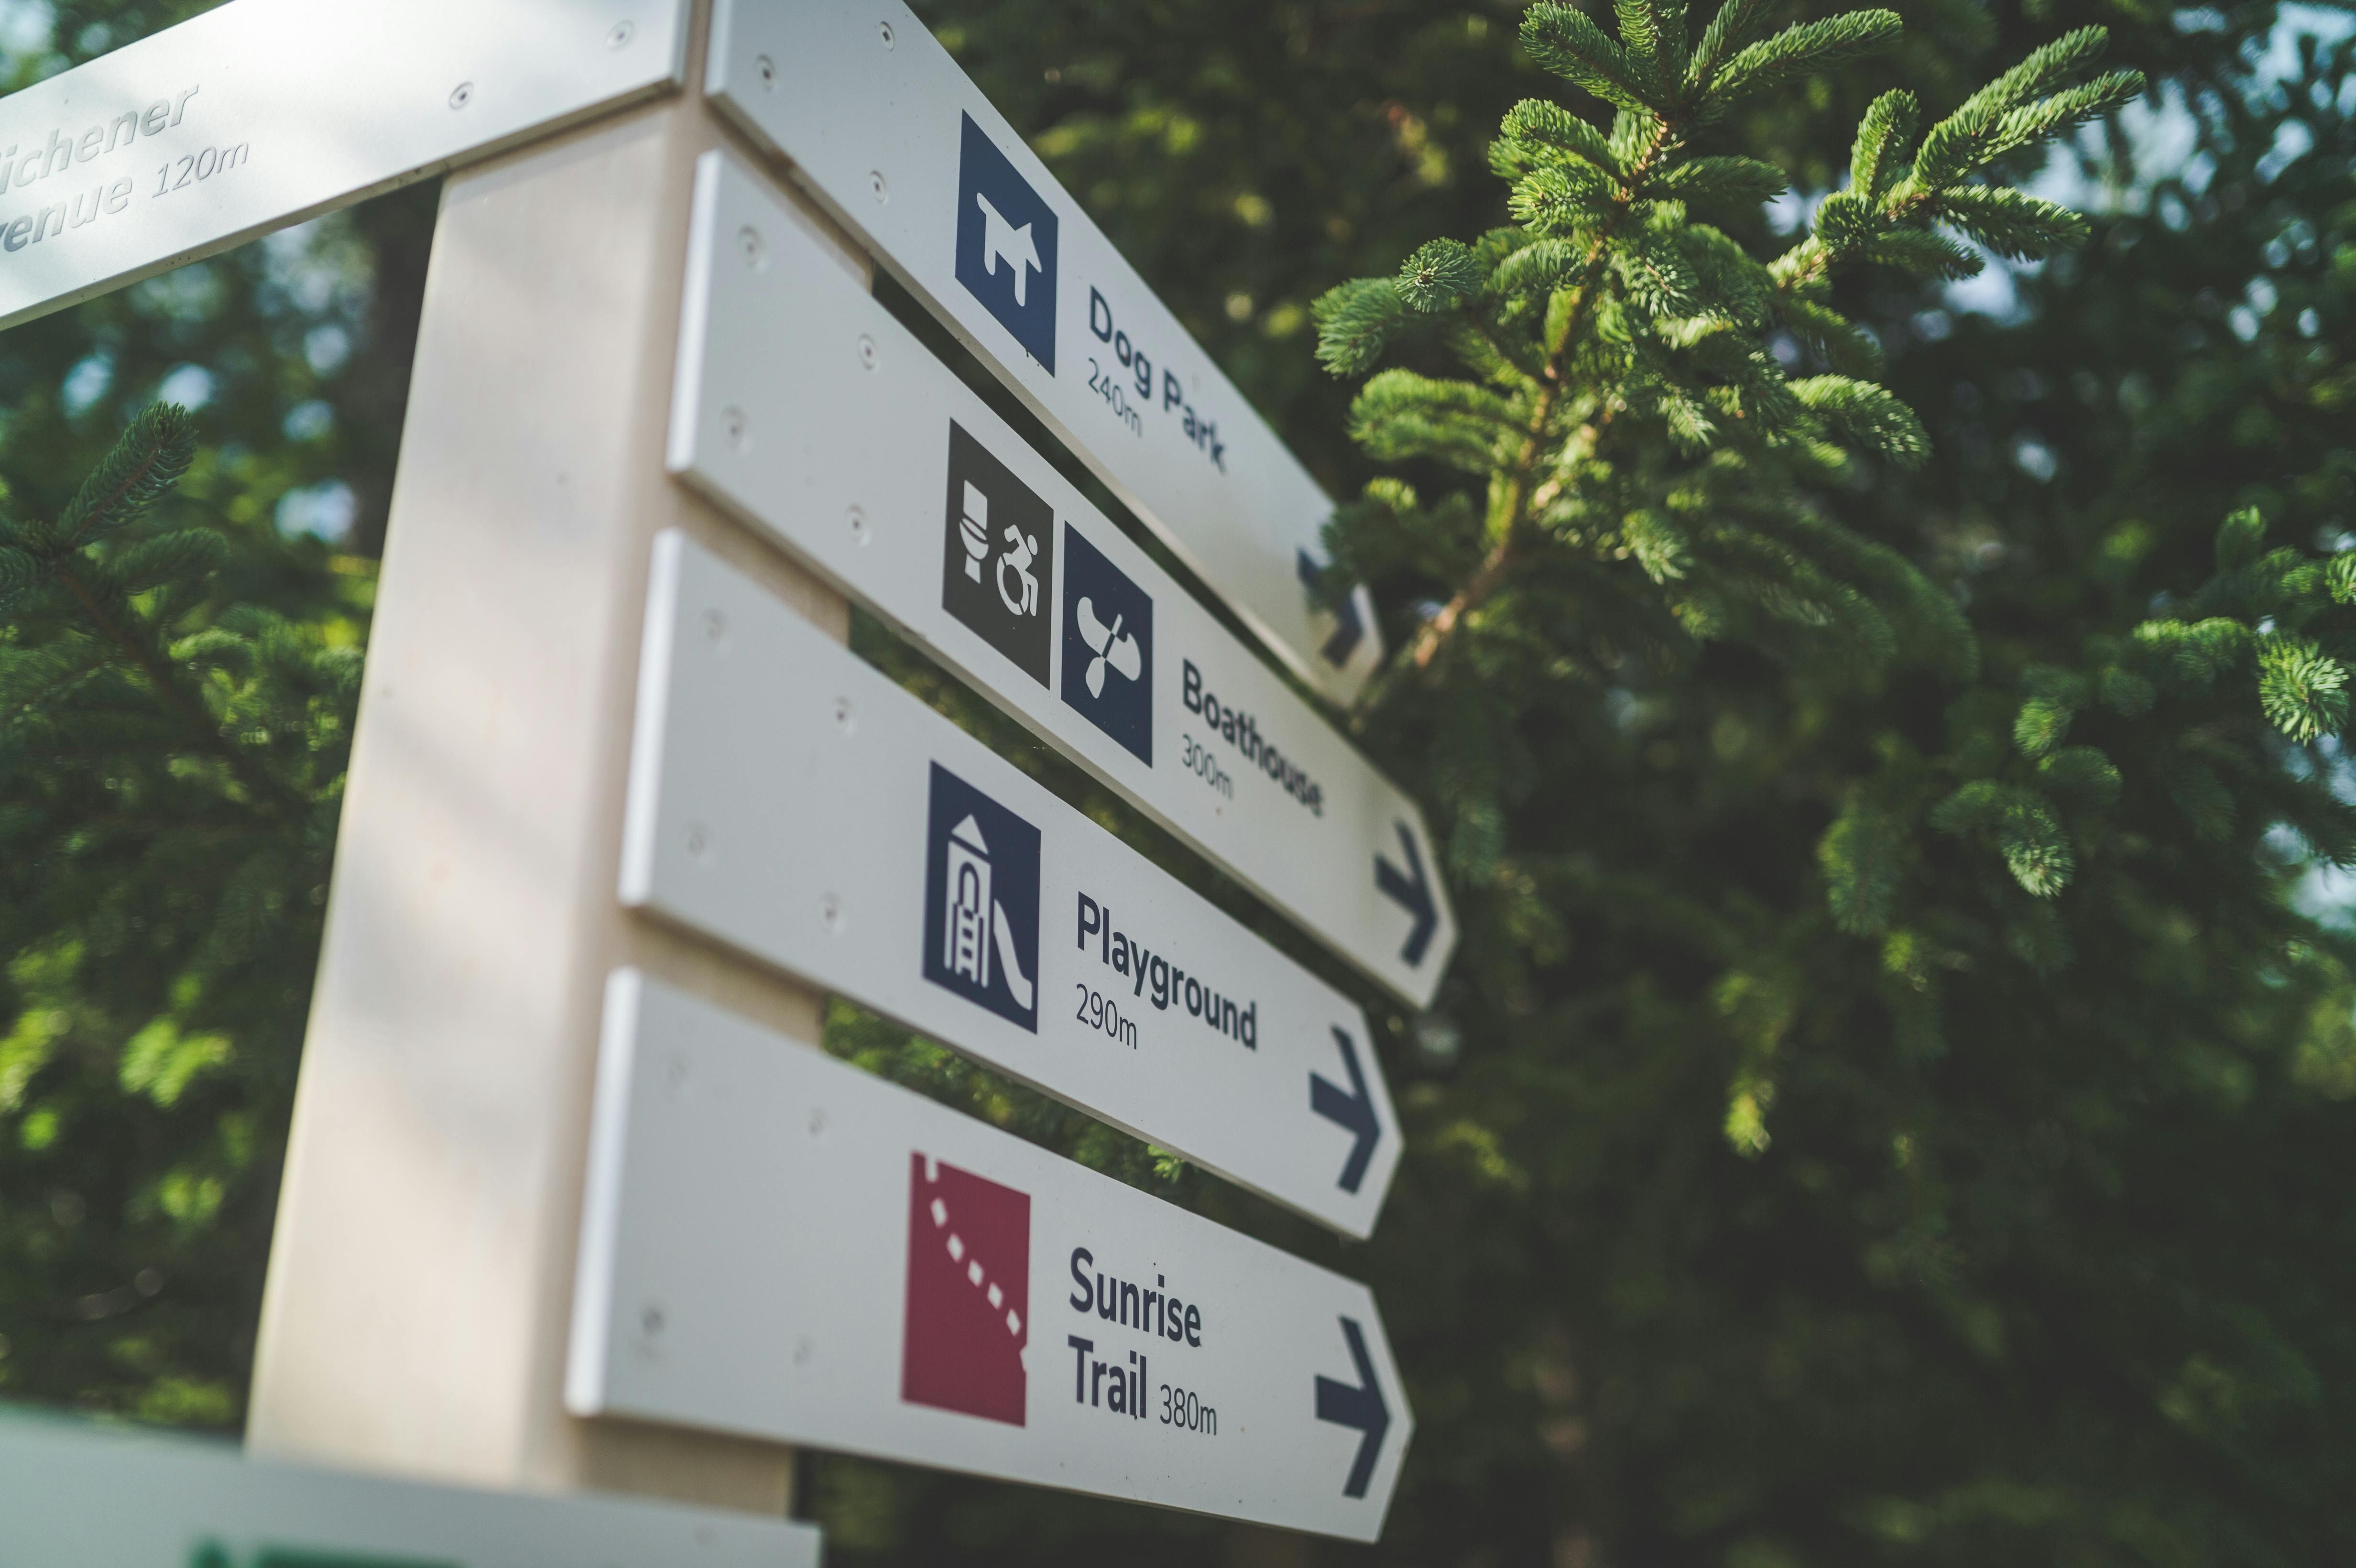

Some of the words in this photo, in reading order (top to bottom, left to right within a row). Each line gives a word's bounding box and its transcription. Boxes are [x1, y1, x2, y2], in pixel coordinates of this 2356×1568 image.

[0, 84, 199, 194] ichener
[151, 142, 248, 198] 120m
[1088, 357, 1143, 438] 240m
[1090, 284, 1151, 400] Dog
[1163, 368, 1227, 475] Park
[1182, 733, 1233, 800] 300m
[1183, 658, 1323, 817] Boathouse
[1076, 983, 1137, 1050] 290m
[1077, 891, 1257, 1051] Playground
[1069, 1247, 1201, 1348] Sunrise
[1068, 1334, 1146, 1419] Trail
[1159, 1384, 1217, 1436] 380m
